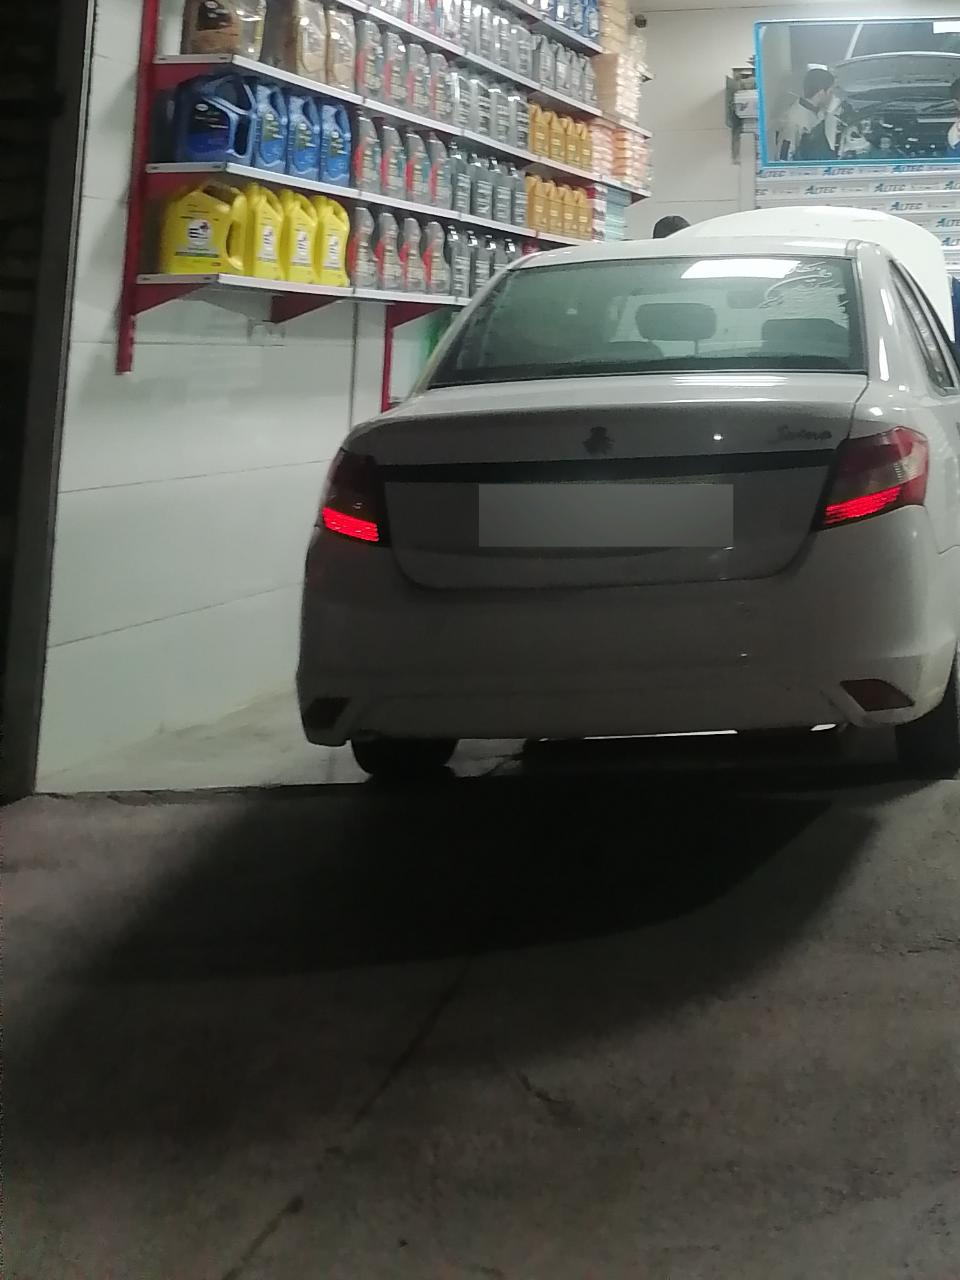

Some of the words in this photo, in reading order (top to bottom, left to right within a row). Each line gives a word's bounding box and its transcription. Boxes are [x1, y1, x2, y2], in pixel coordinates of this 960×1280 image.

[823, 167, 854, 176] ALTEC
[804, 185, 837, 195] ALTEC
[874, 183, 906, 192] ALTEC
[890, 202, 923, 210] ALTEC
